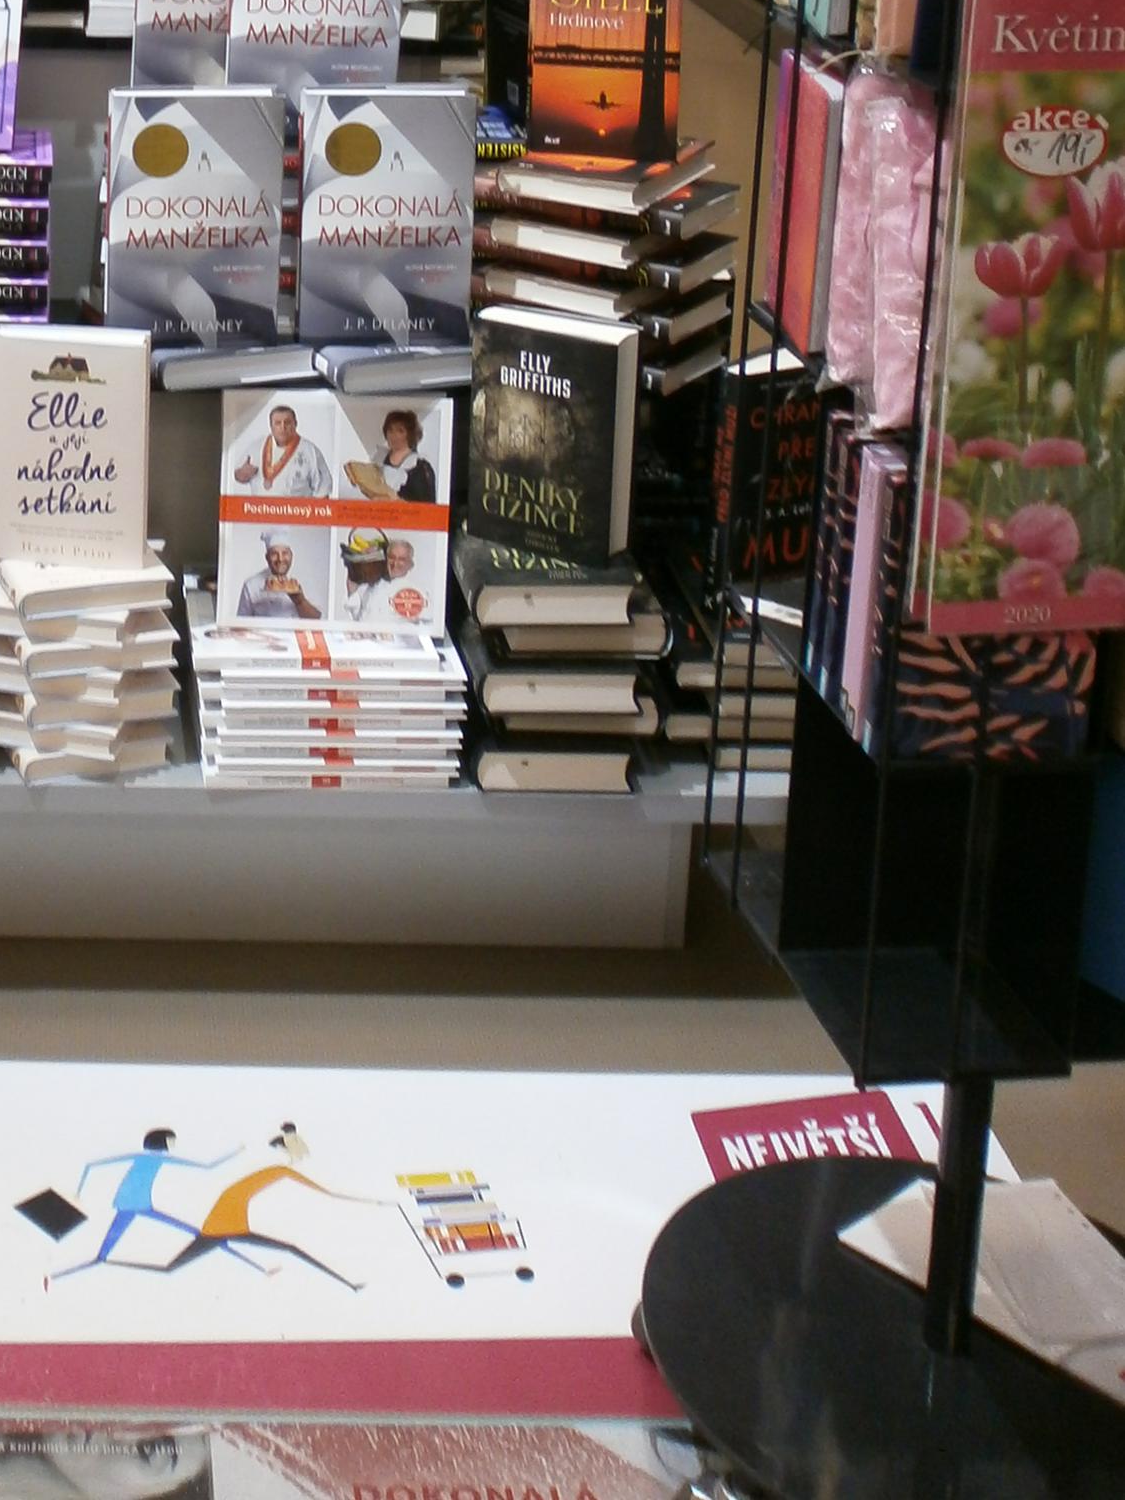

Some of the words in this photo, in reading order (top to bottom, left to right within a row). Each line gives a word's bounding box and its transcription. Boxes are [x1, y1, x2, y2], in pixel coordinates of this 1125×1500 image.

[151, 8, 230, 35] MANŽ
[246, 18, 389, 49] MANŽELKA
[549, 12, 624, 31] Hrdinové
[992, 11, 1125, 54] Květin
[1012, 105, 1091, 132] akce
[125, 189, 269, 219] DOKONALÁ
[318, 188, 461, 219] DOKONALÁ
[125, 221, 270, 250] MANŽELKA
[318, 220, 462, 249] MANŽELKA
[152, 320, 162, 333] J.
[165, 320, 176, 333] P.
[180, 319, 244, 334] DELANEY
[343, 318, 353, 332] J.
[357, 318, 368, 332] P.
[372, 317, 436, 332] DELANEY
[520, 350, 552, 375] ELLY
[500, 365, 572, 399] GRIFFITHS
[27, 391, 108, 431] Ellie
[62, 431, 89, 451] její
[17, 449, 118, 482] náhodné
[17, 482, 117, 516] setkání
[243, 502, 312, 518] Pochoutkový
[315, 504, 333, 517] rok
[1003, 604, 1052, 623] 2020
